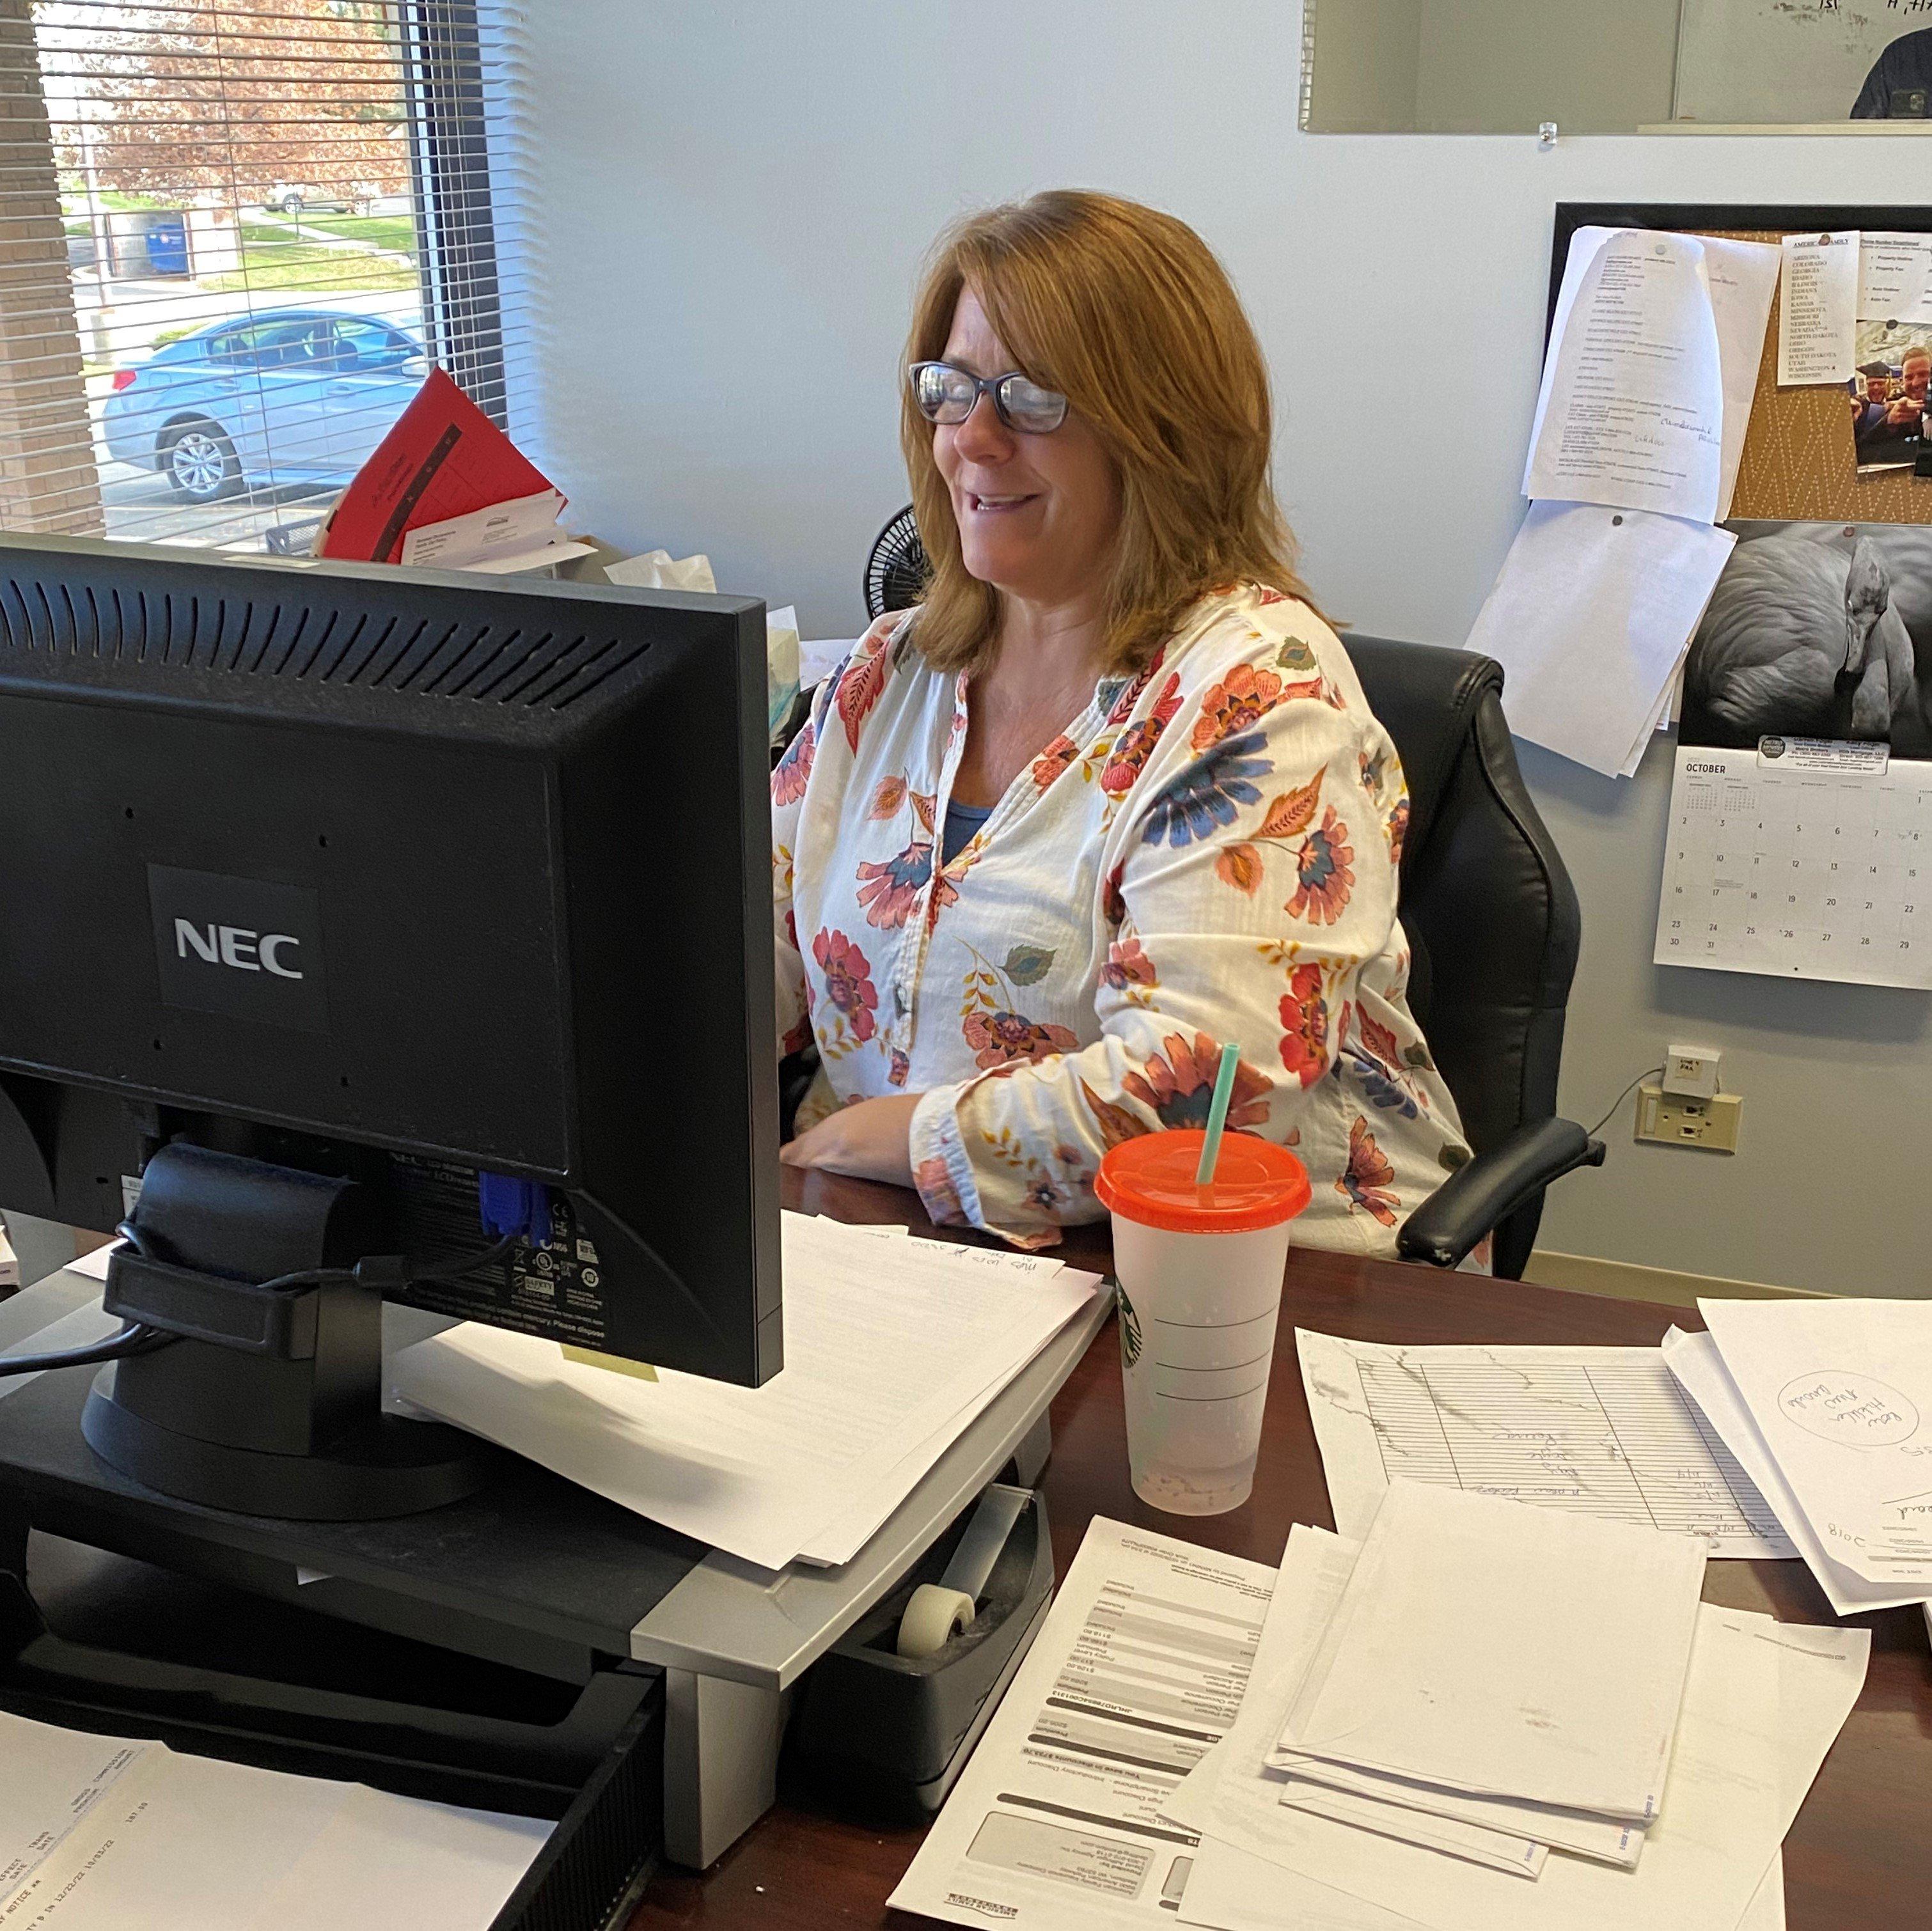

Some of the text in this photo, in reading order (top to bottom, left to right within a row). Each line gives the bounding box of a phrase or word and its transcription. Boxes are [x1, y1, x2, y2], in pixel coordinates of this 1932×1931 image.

[1686, 763, 1725, 774] OCTOBER
[1835, 827, 1841, 835] 6
[1913, 833, 1919, 841] 8
[1716, 854, 1724, 863] 10
[1754, 857, 1760, 865] 11
[1830, 863, 1838, 871] 13
[1869, 866, 1877, 874] 14
[1908, 869, 1917, 877] 15
[1675, 886, 1914, 914] 16 17 18 19 20 21 22
[1670, 938, 1714, 949] 30 31
[1672, 921, 1910, 950] 23 24 25 26 27 28 29
[175, 918, 303, 980] NEC
[553, 1319, 605, 1338] Please dispose
[1828, 1523, 1866, 1547] 2018
[1035, 1725, 1067, 1736] Premium
[93, 1749, 128, 1783] COMMISSION
[1054, 1755, 1093, 1768] discounts
[1027, 1760, 1159, 1794] Smartphone Introductory Discount
[1112, 1789, 1145, 1801] Discount
[1122, 1811, 1156, 1824] Discount
[9, 1864, 27, 1879] DATE
[36, 1836, 55, 1850] DATE
[1016, 1861, 1046, 1872] Company
[1047, 1870, 1079, 1880] Insurance
[54, 1872, 84, 1902] 12/22/22
[1102, 1883, 1133, 1895] American
[6, 1889, 31, 1914] NOTICE
[945, 1896, 1016, 1916] AMERICAN FAMILY
